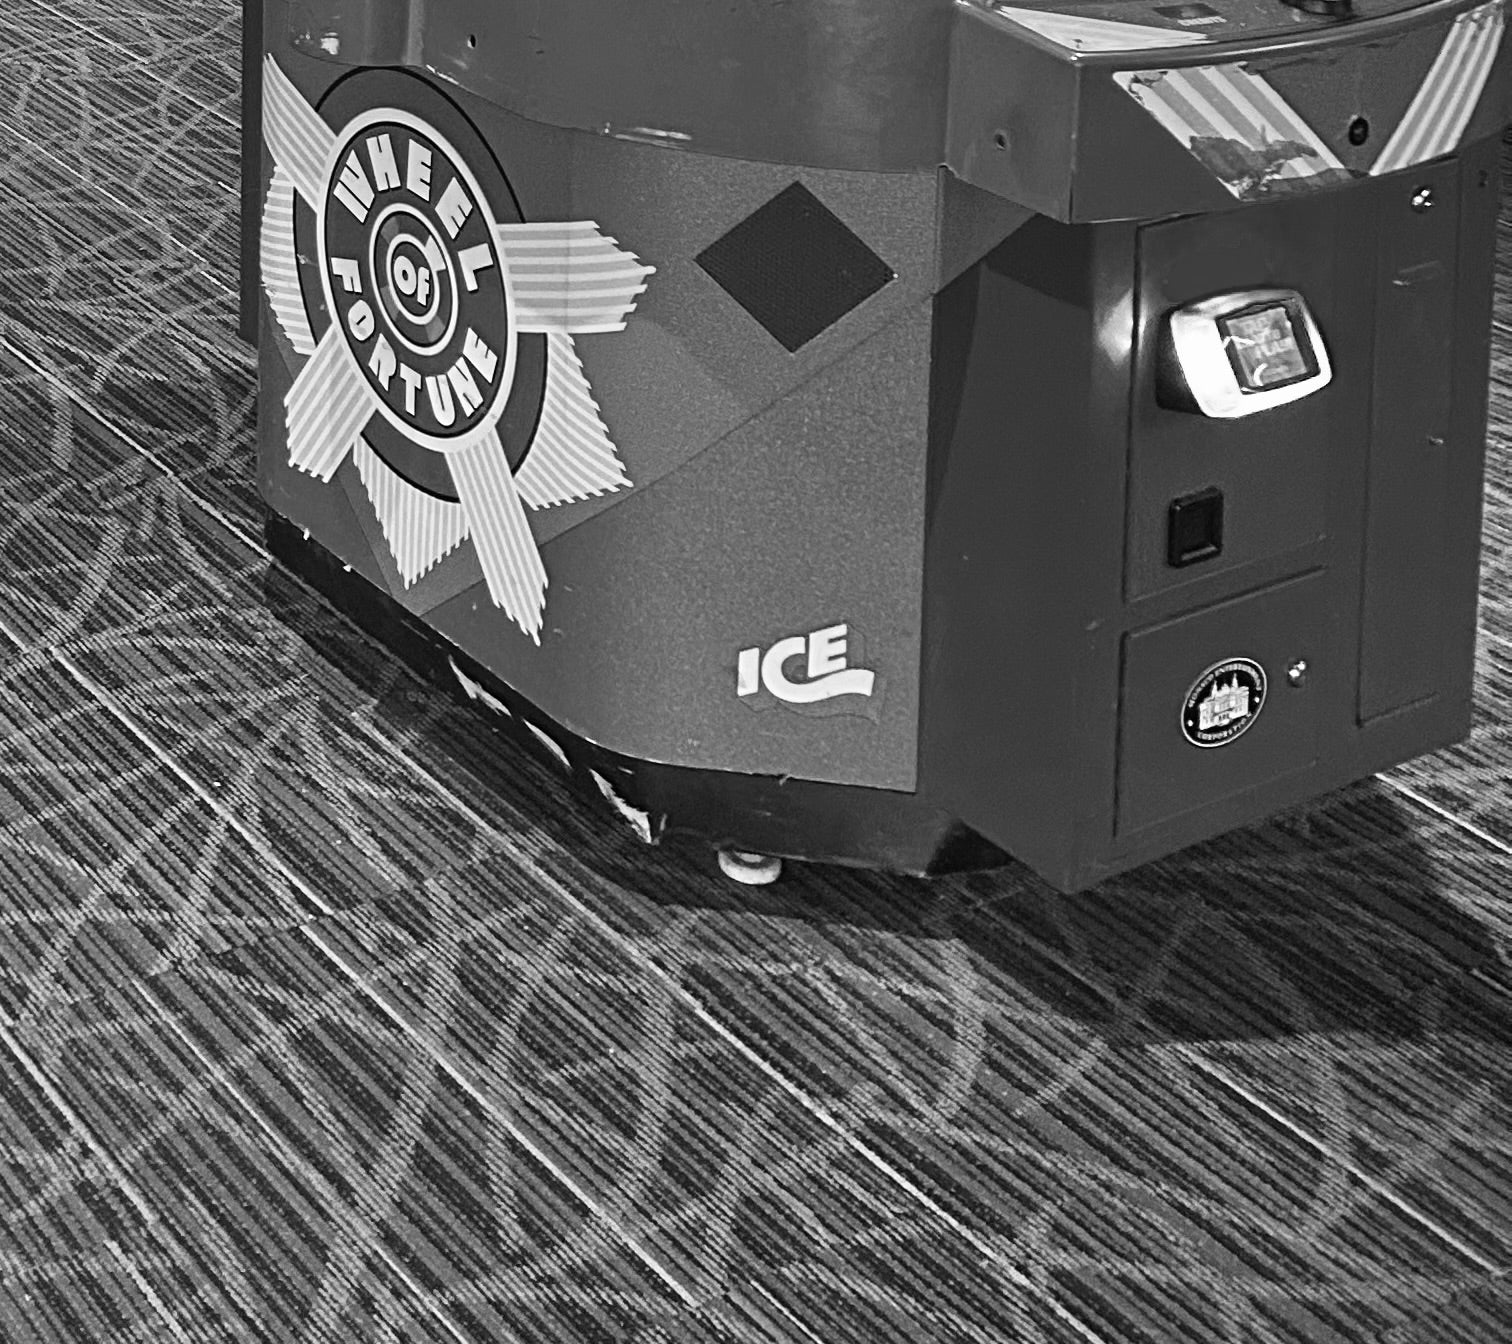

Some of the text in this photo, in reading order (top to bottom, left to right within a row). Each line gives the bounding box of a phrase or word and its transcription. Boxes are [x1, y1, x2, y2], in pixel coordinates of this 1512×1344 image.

[333, 133, 495, 293] WHEEL
[393, 254, 431, 306] OF
[330, 256, 498, 427] FORTUNE
[736, 624, 875, 704] ICE
